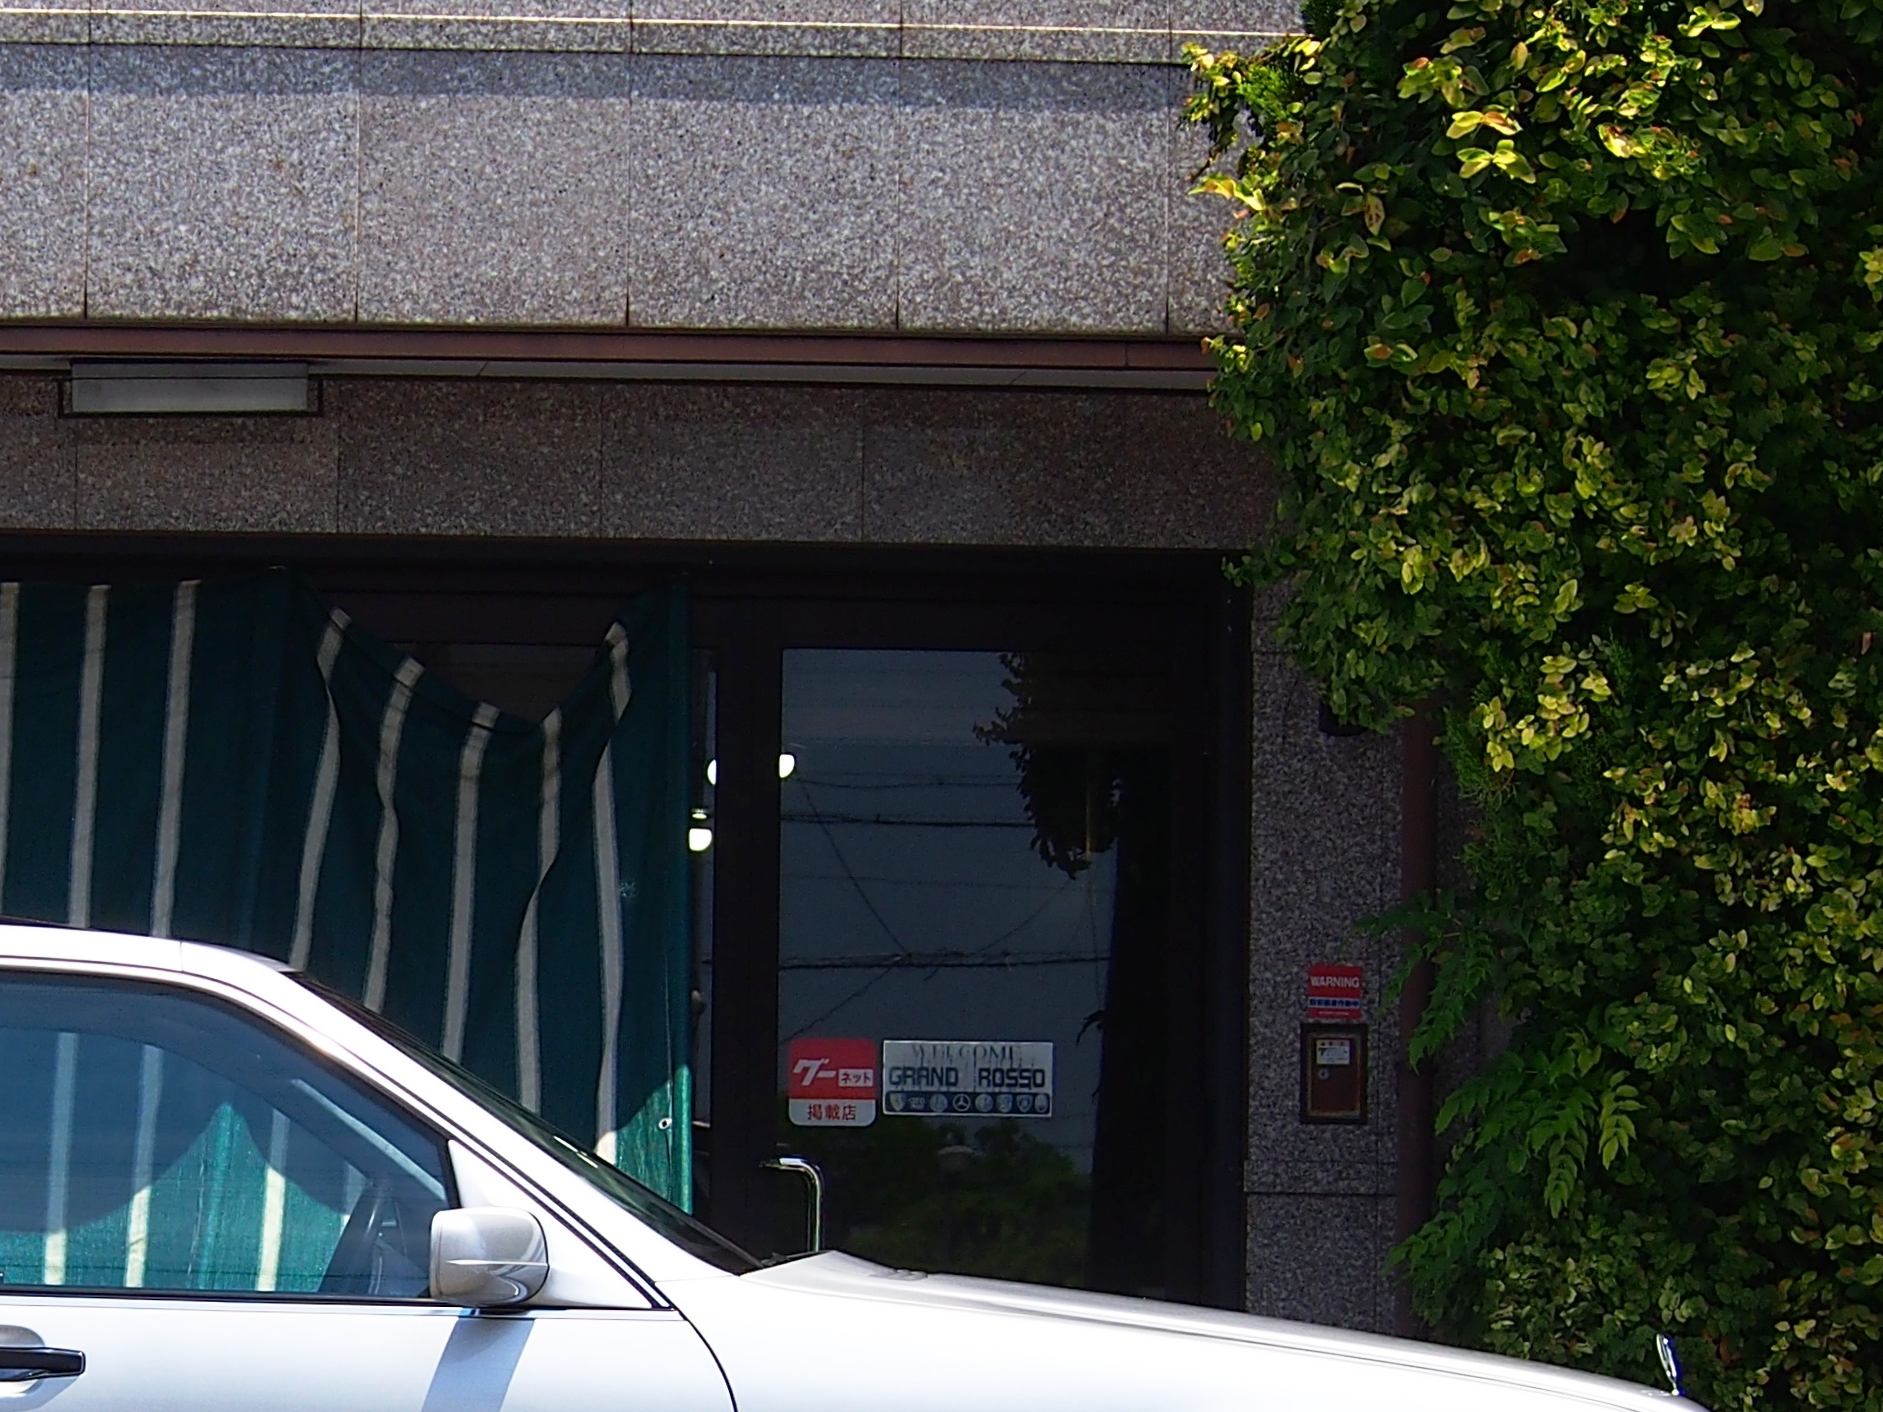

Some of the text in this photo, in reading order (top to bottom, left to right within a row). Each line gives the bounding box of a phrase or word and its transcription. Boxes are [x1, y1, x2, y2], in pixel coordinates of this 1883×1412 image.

[1311, 976, 1359, 988] WARNING
[888, 1066, 1046, 1089] GRAND ROSSO
[807, 1104, 857, 1121] 掲載店
